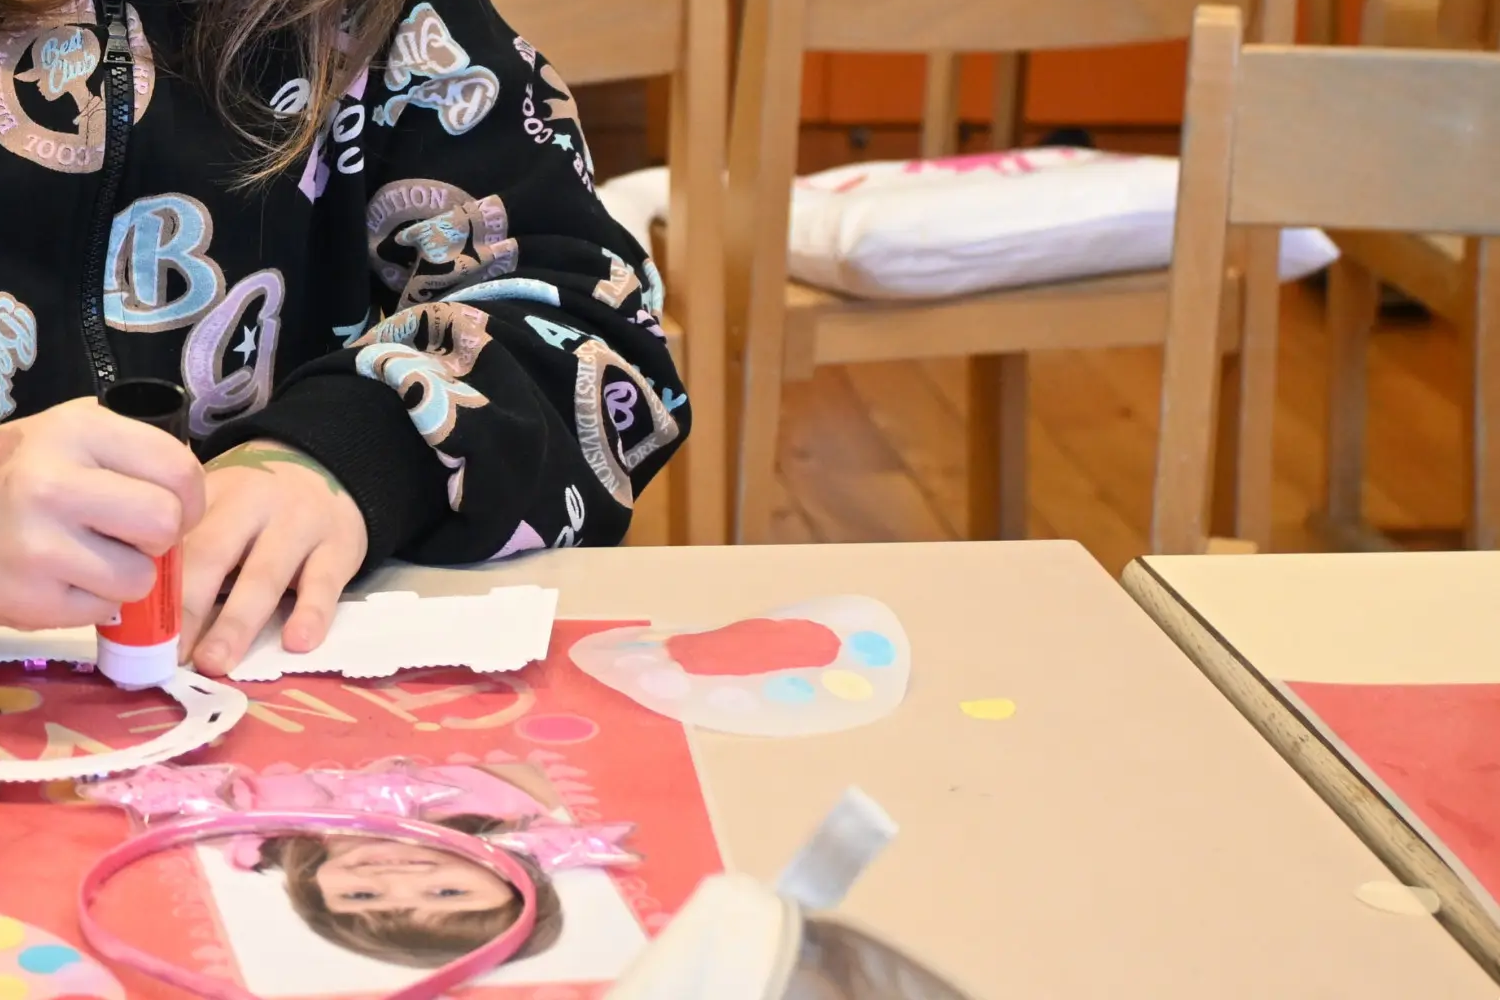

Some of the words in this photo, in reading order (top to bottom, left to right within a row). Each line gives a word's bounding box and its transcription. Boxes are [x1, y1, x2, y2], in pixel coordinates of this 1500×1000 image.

[25, 133, 90, 166] COOL
[366, 185, 449, 234] EDITION
[577, 413, 620, 494] DIVISION
